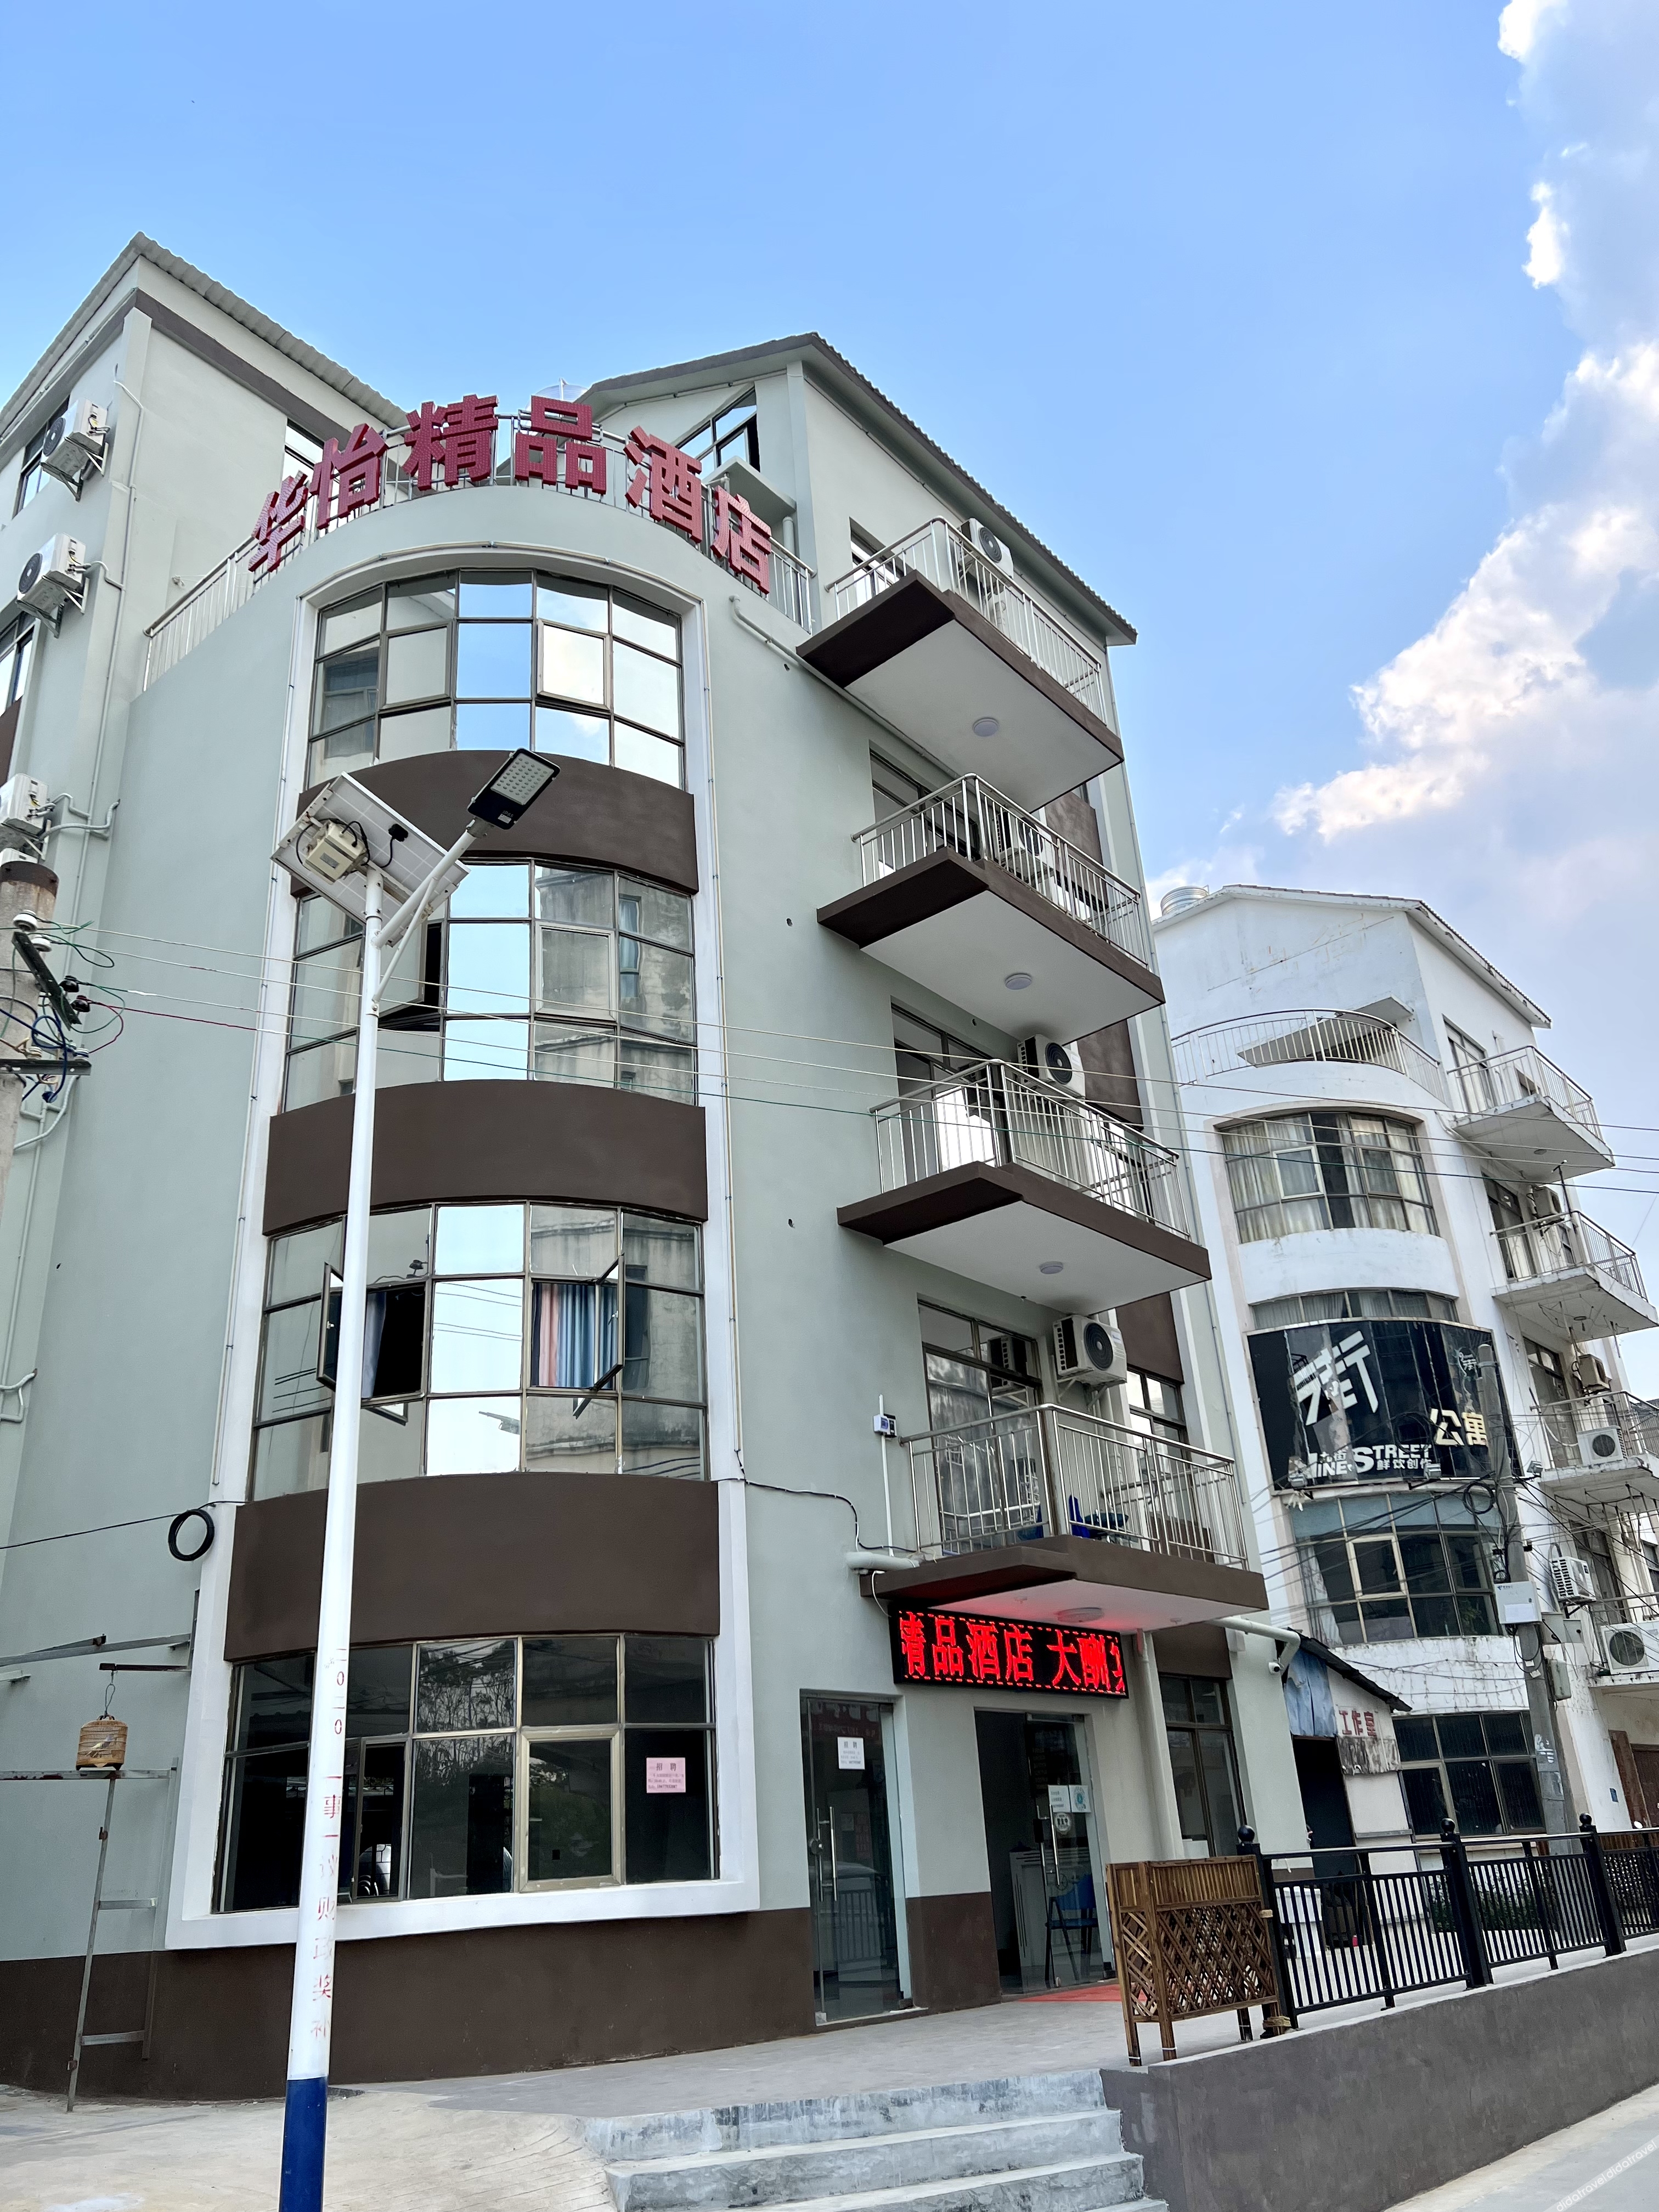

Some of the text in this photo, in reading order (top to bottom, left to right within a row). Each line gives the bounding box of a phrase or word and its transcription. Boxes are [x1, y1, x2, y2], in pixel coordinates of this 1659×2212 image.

[248, 393, 772, 595] 华怡精品酒店
[1429, 1408, 1488, 1447] 公寓
